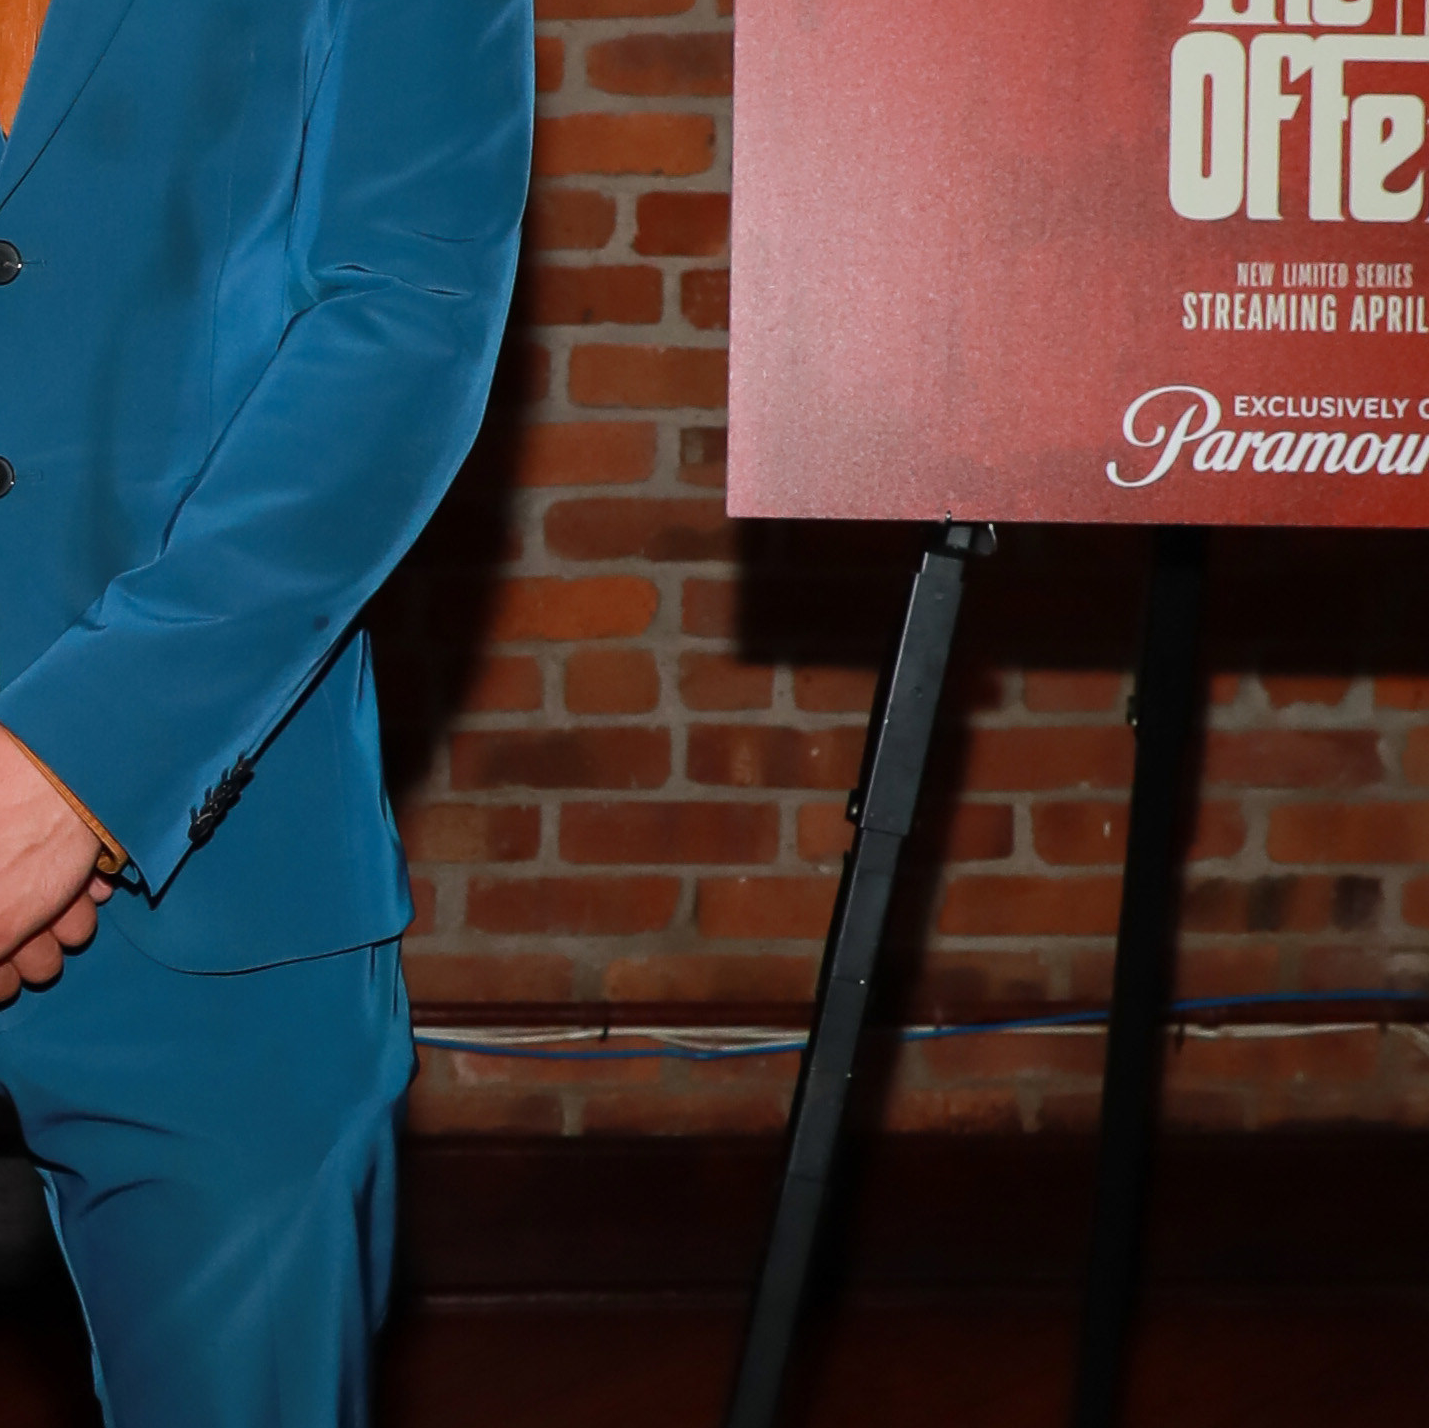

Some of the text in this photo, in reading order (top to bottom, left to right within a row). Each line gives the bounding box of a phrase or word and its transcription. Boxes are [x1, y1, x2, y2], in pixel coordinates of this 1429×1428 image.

[1170, 30, 1429, 222] Offe
[1237, 262, 1414, 289] NEW LIMITED SERIES
[1182, 292, 1429, 334] STREAMING APRIL
[1234, 395, 1410, 420] EXCLUSIVELY
